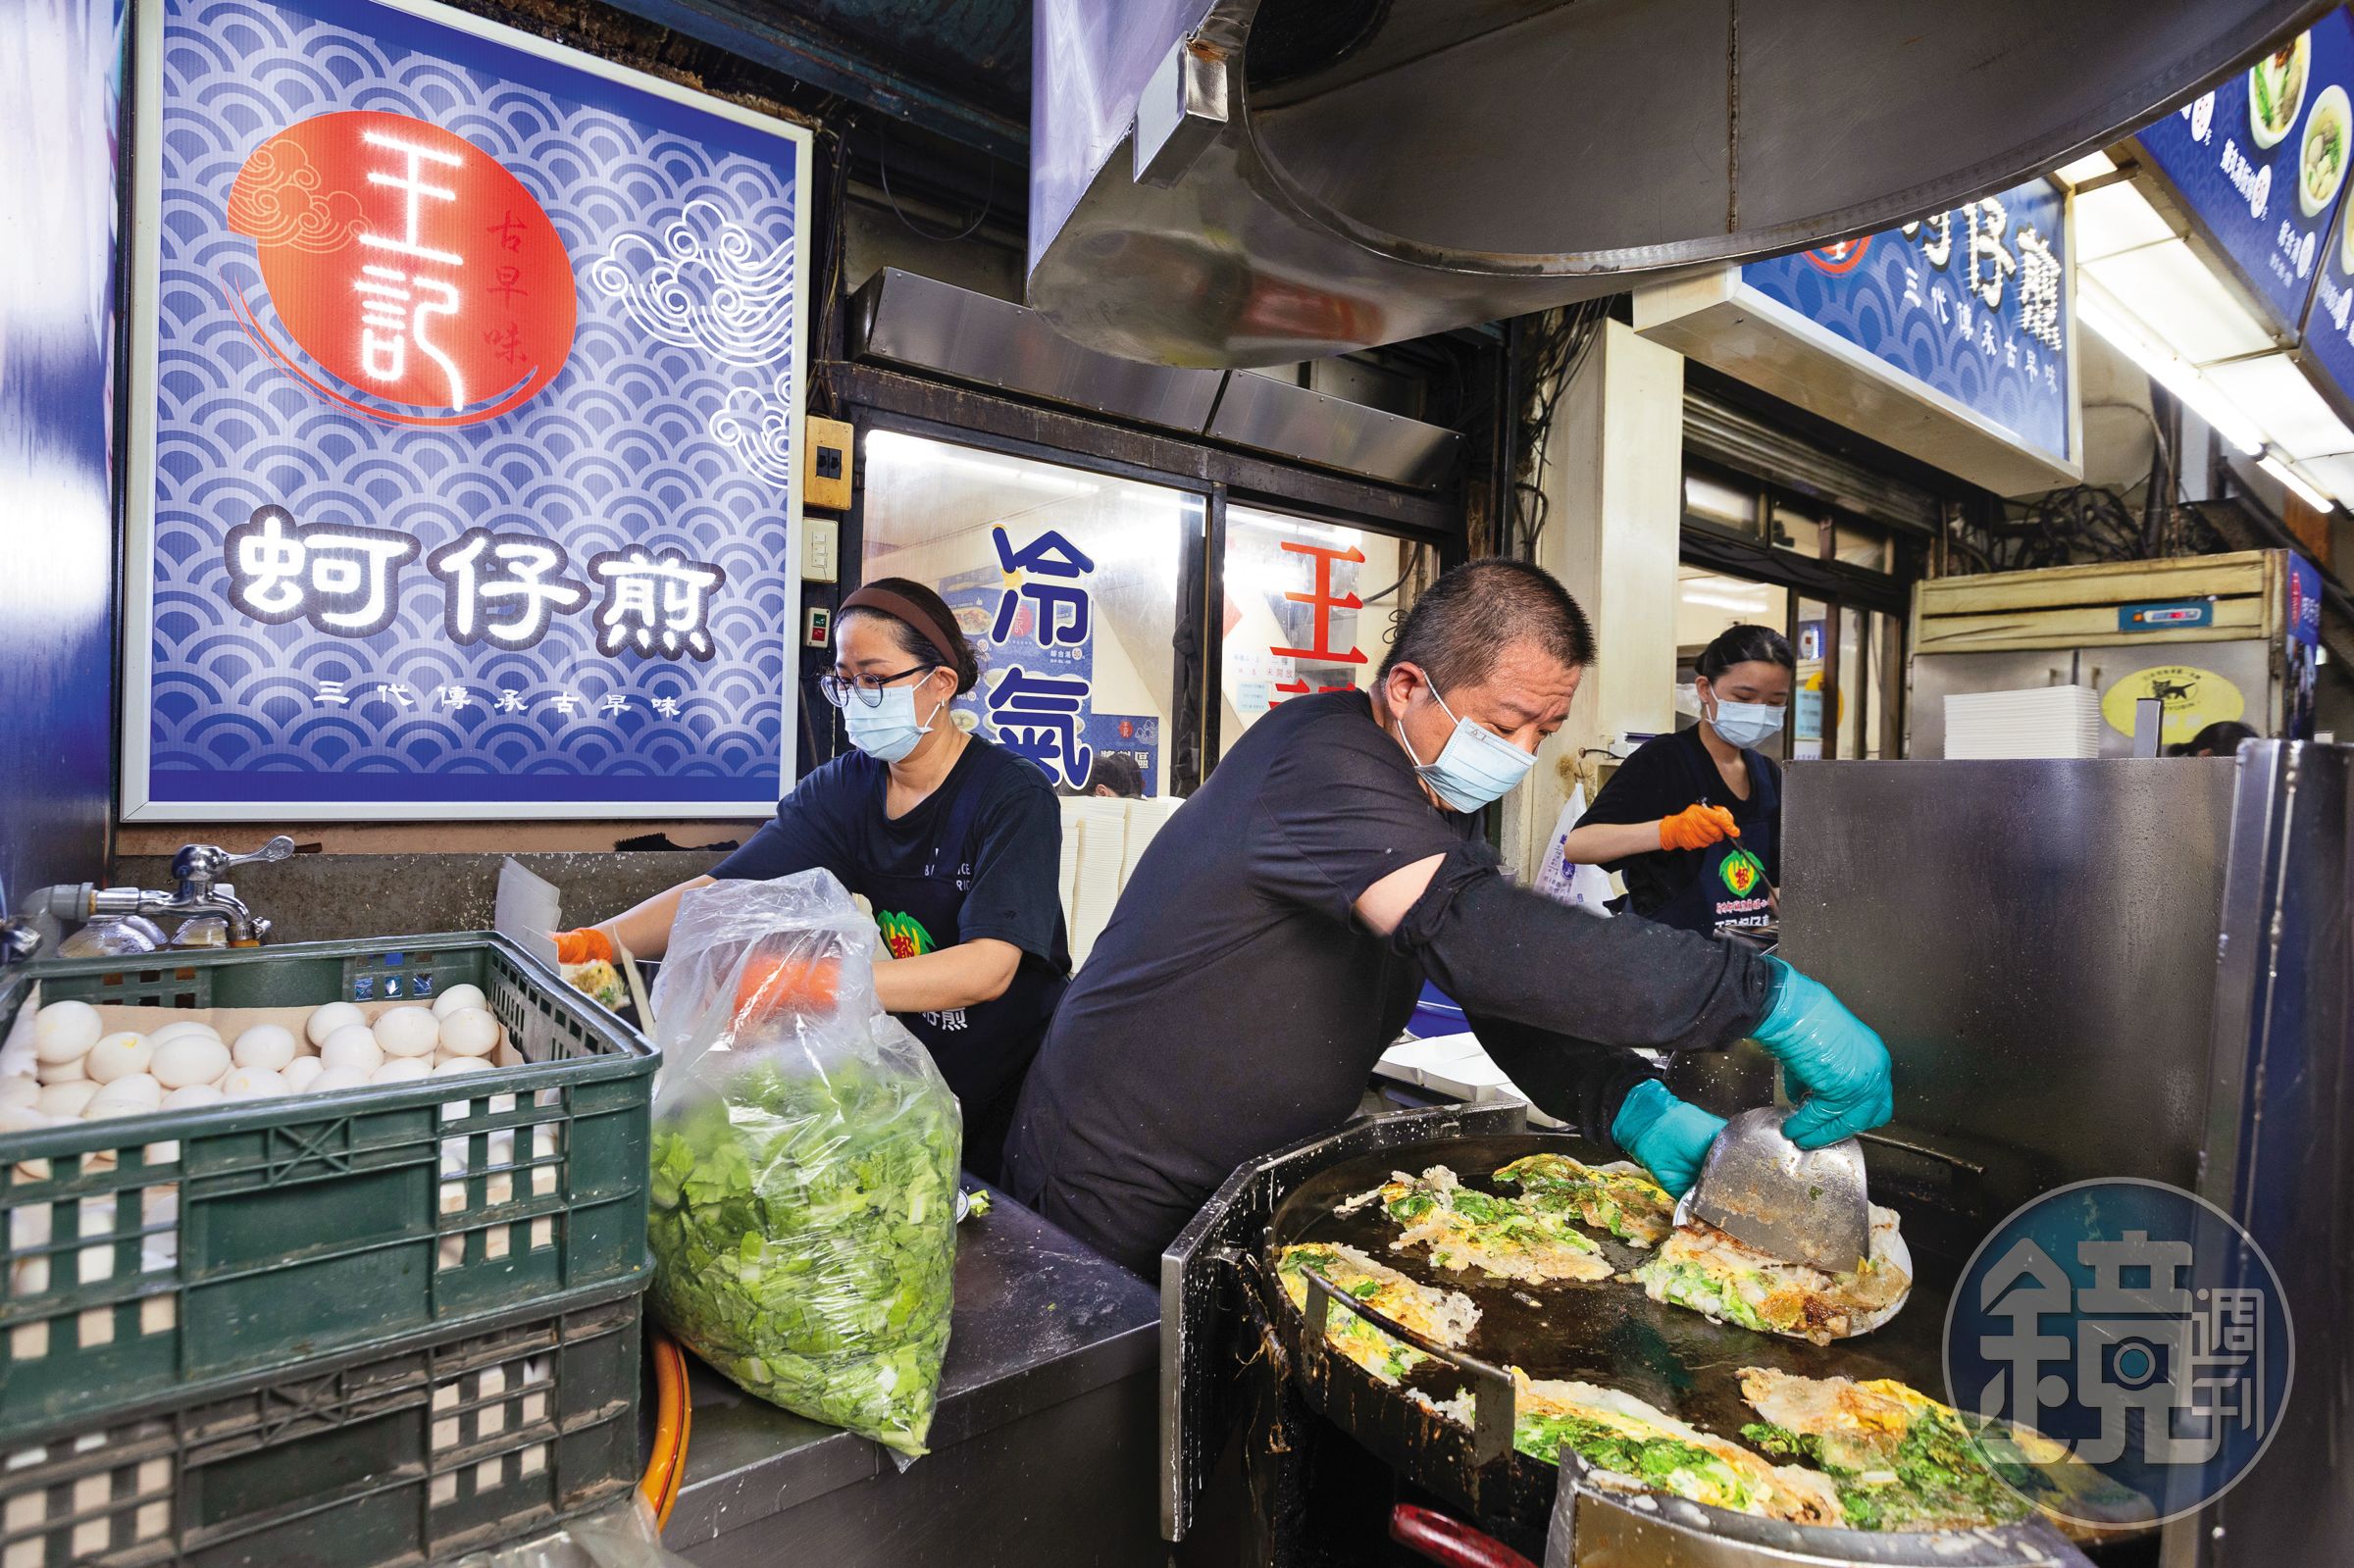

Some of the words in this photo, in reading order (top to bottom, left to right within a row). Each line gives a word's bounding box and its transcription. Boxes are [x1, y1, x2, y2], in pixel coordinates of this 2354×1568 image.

[356, 128, 465, 412] 王記
[484, 209, 530, 366] 古早味
[1903, 266, 2058, 394] 三代傳承古早味
[232, 510, 722, 658] 蚵仔煎
[988, 525, 1095, 790] 冷氣
[312, 680, 683, 719] 三代傳承古早味
